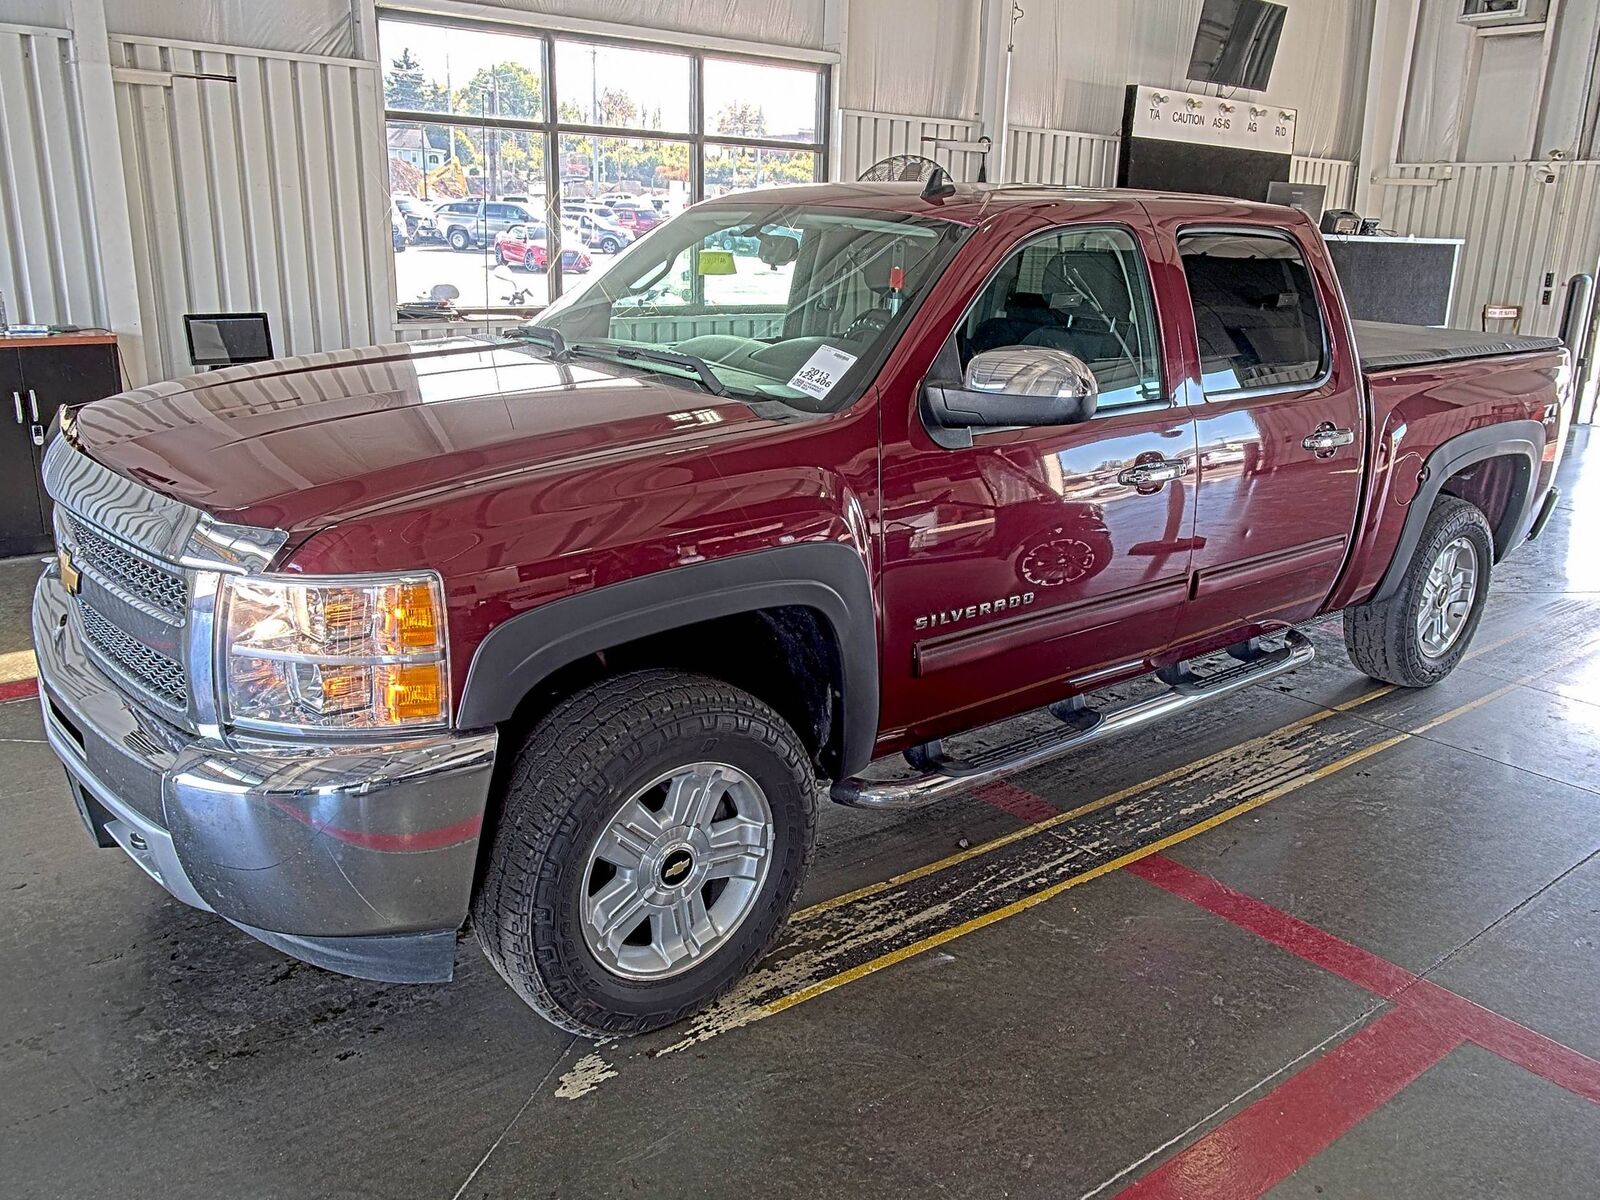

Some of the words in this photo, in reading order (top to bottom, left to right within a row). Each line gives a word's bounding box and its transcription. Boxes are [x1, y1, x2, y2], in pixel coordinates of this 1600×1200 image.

[1149, 108, 1160, 121] T/A
[1172, 111, 1205, 126] CAUTION
[1212, 117, 1231, 129] AS-IS
[1247, 122, 1257, 133] AG
[798, 371, 832, 388] 125,406
[808, 367, 830, 379] 2013
[913, 591, 1035, 630] SILVERADO
